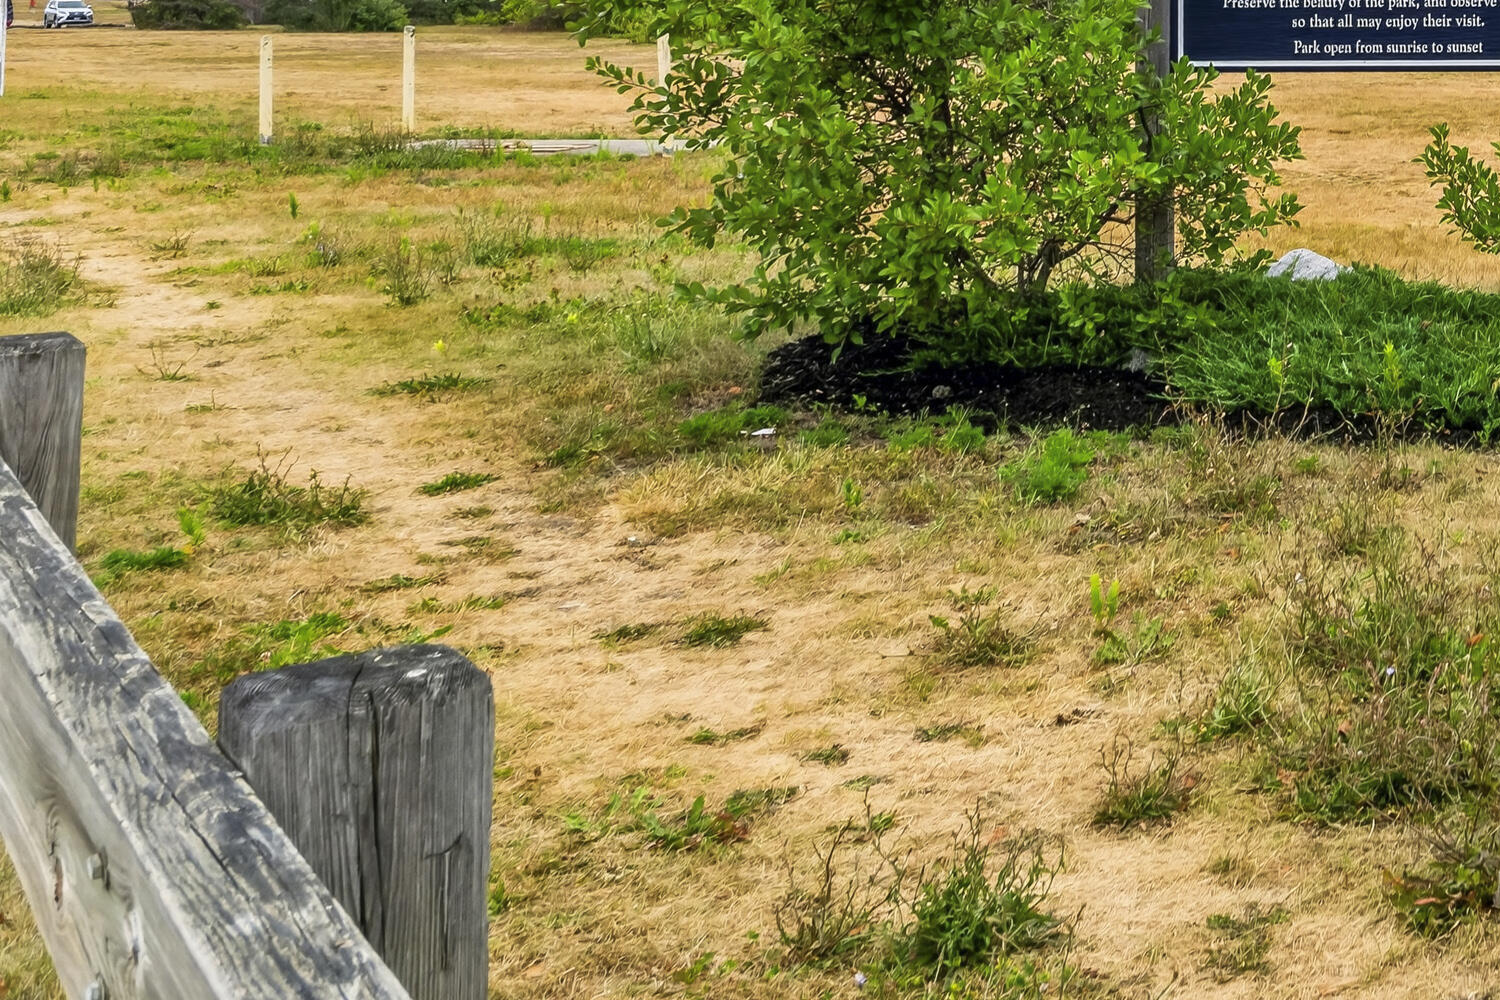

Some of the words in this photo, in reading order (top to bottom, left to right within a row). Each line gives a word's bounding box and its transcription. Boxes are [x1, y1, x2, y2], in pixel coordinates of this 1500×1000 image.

[1291, 18, 1306, 28] so
[1309, 13, 1335, 28] that
[1337, 13, 1353, 28] all
[1356, 17, 1383, 31] may
[1385, 14, 1419, 31] enjoy
[1422, 12, 1453, 28] their
[1454, 13, 1485, 28] visit.
[1293, 39, 1321, 55] Park
[1323, 44, 1353, 57] open
[1355, 39, 1384, 54] from
[1386, 39, 1429, 54] sunrise
[1431, 41, 1444, 54] to
[1446, 41, 1483, 54] sunset
